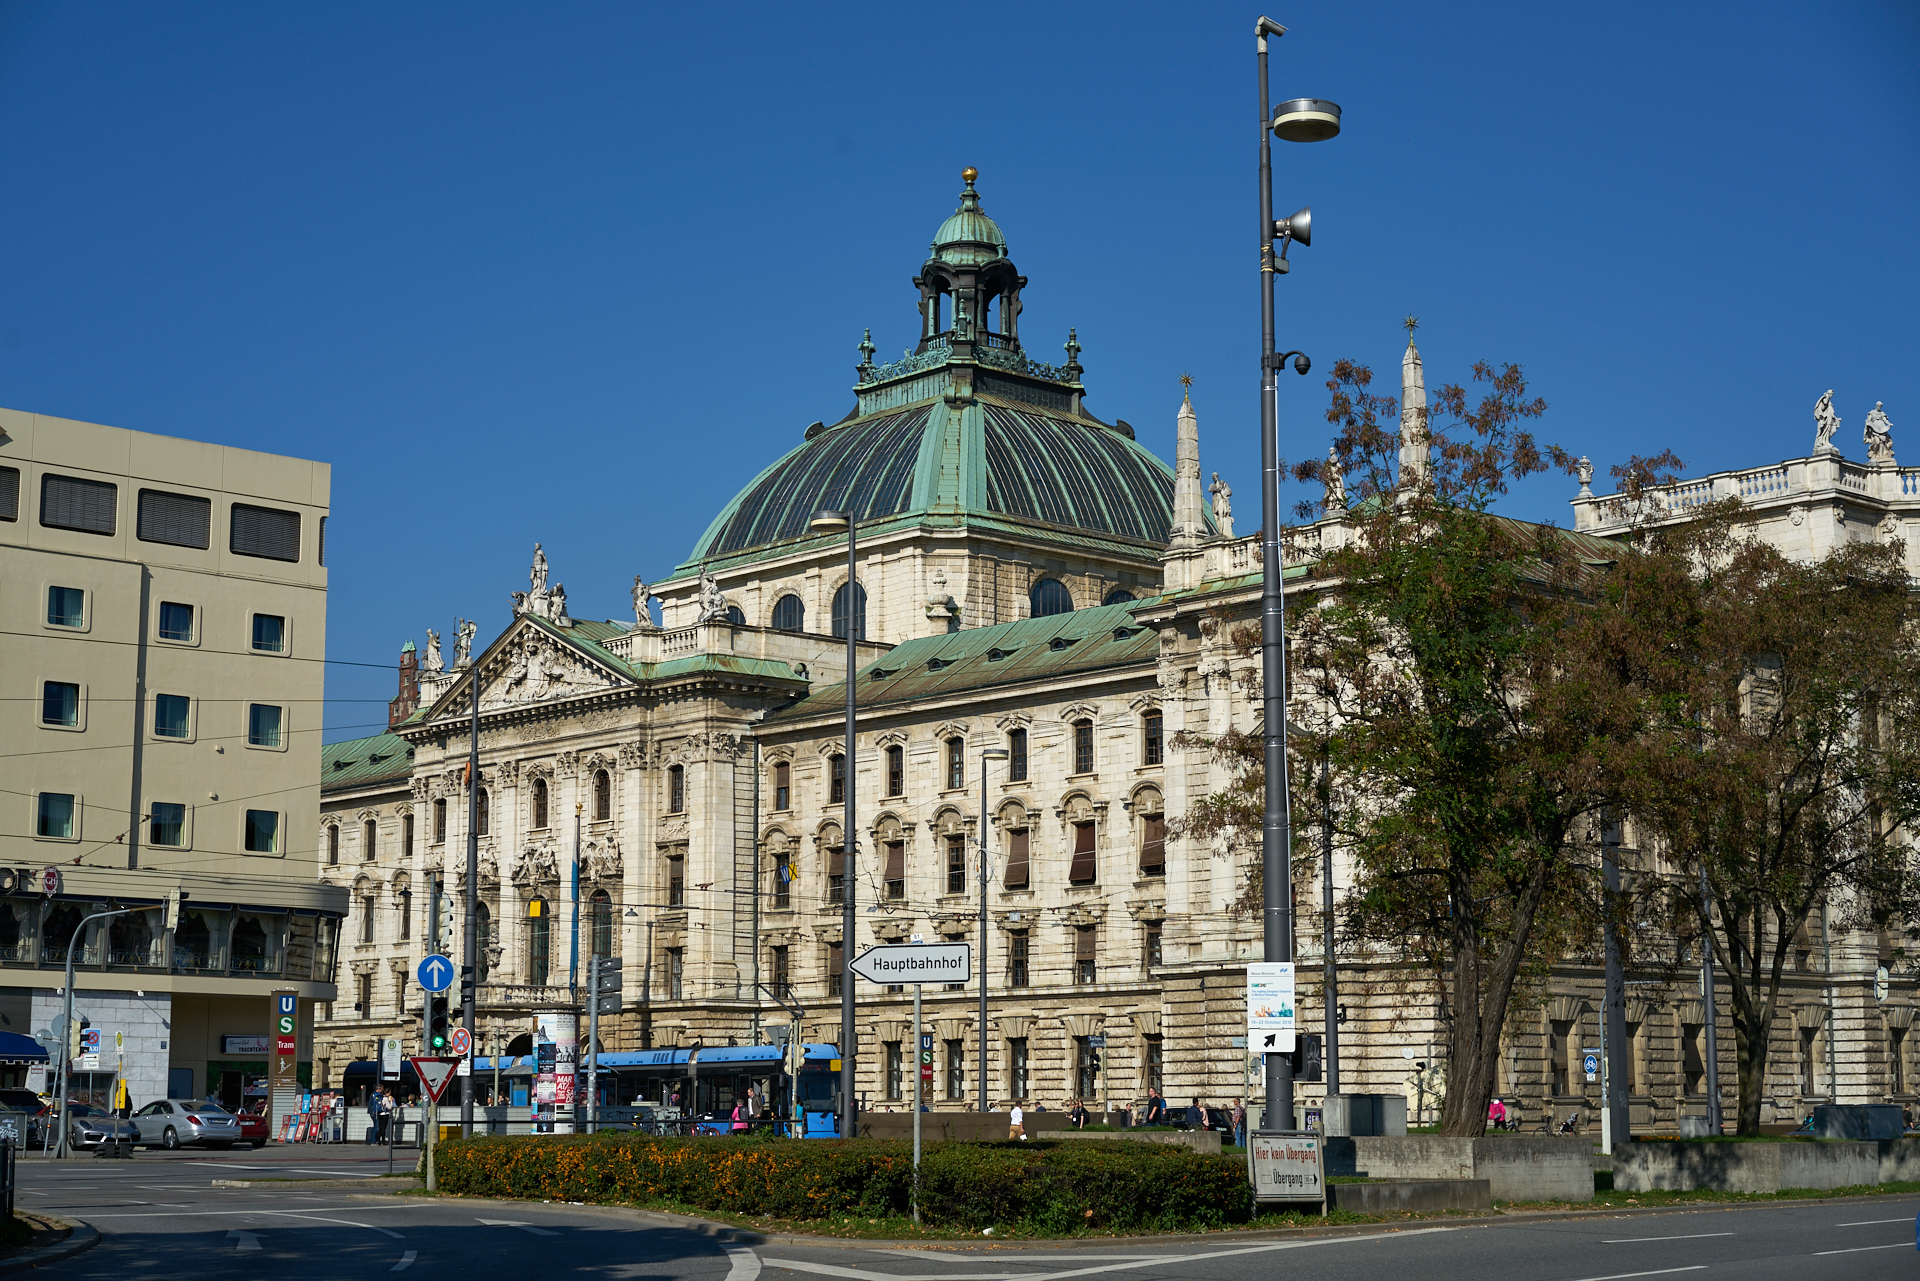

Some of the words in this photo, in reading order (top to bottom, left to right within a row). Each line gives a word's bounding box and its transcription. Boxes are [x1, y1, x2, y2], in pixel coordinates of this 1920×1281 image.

[873, 956, 963, 973] Hauptbahnhof
[281, 997, 293, 1012] U
[280, 1017, 293, 1033] S
[277, 1041, 295, 1049] Tram
[923, 1037, 931, 1048] U
[922, 1051, 931, 1064] S
[557, 1075, 573, 1083] MAR
[1255, 1147, 1269, 1160] Hier
[1270, 1147, 1285, 1160] kein
[1286, 1144, 1316, 1163] Übergang
[1273, 1168, 1304, 1188] Übergang
